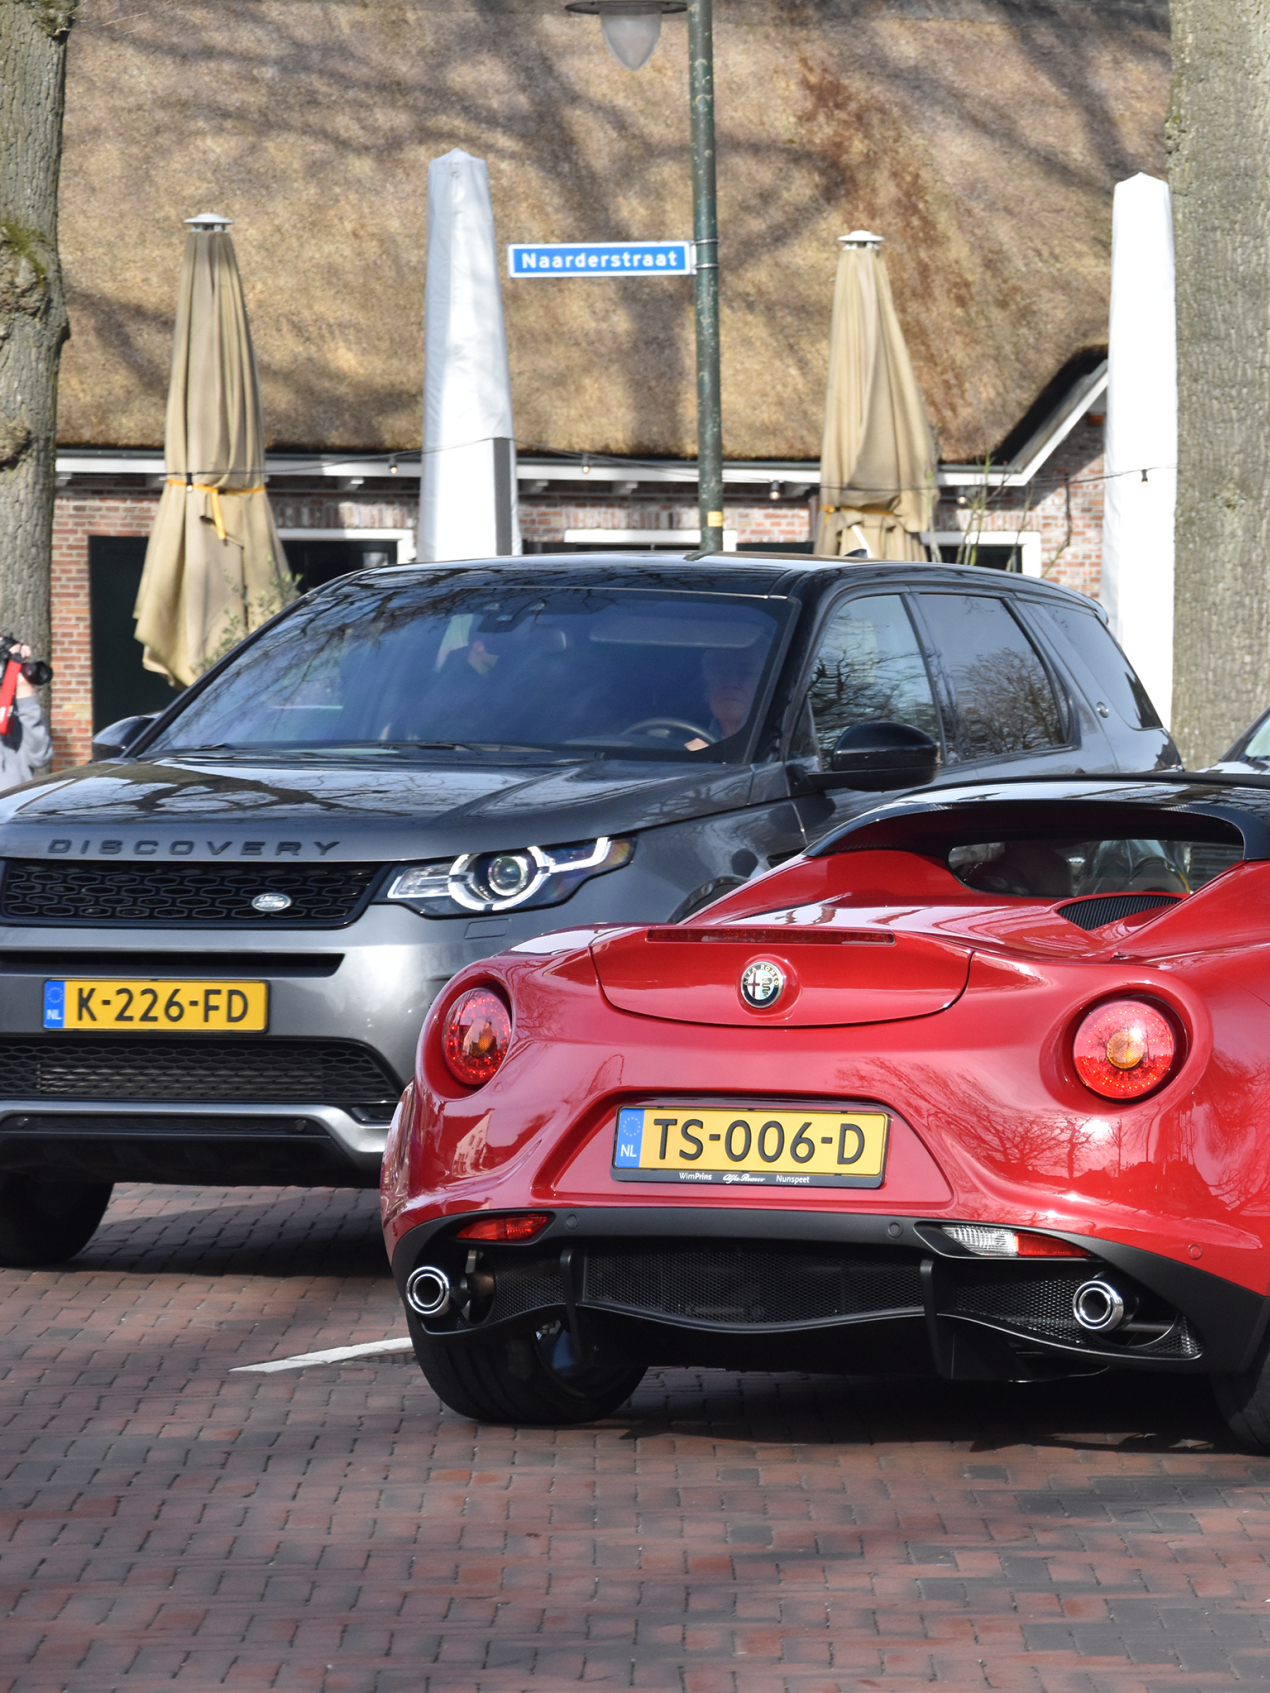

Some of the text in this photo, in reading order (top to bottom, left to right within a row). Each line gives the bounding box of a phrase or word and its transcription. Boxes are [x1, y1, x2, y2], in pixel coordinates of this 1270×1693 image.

[522, 251, 677, 268] Naarderstraat
[47, 839, 340, 856] DISCOVERY
[46, 988, 249, 1023] NL K-226-FD
[620, 1118, 866, 1165] NL TS-006-D
[775, 1174, 810, 1185] Nunspeet
